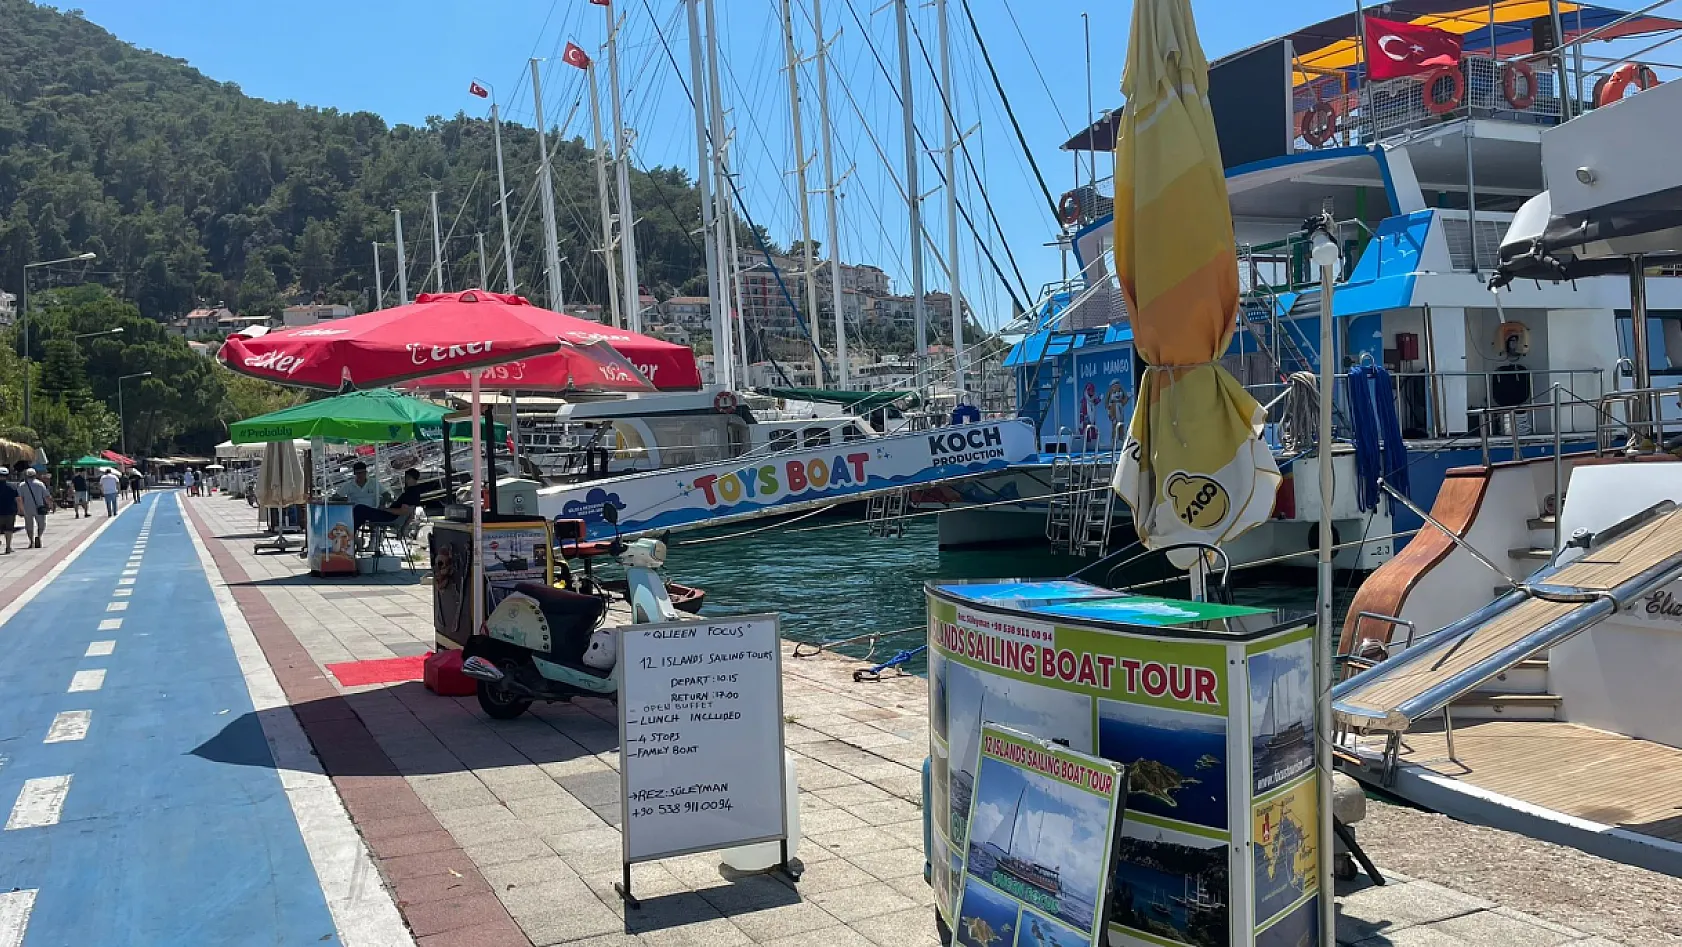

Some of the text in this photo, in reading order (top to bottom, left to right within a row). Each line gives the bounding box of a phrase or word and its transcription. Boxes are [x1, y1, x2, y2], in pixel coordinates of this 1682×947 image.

[928, 427, 1002, 456] KOCH
[933, 448, 1005, 467] PRODUCTION
[693, 452, 870, 506] TOYS BOAT
[639, 650, 773, 670] 12 ISLANDS SAILING TOURS
[966, 630, 1036, 676] SAILING
[1041, 646, 1115, 689] BOAT
[1121, 658, 1219, 705] TOUR
[643, 701, 713, 713] OPEN BUFFET
[690, 711, 741, 722] INCLUDED
[650, 732, 681, 742] STOPS
[672, 745, 700, 755] BOAT
[984, 735, 1113, 796] 12 ISLANDS SAILING BOAT TOUR
[632, 806, 654, 818] +90
[658, 804, 680, 815] 538
